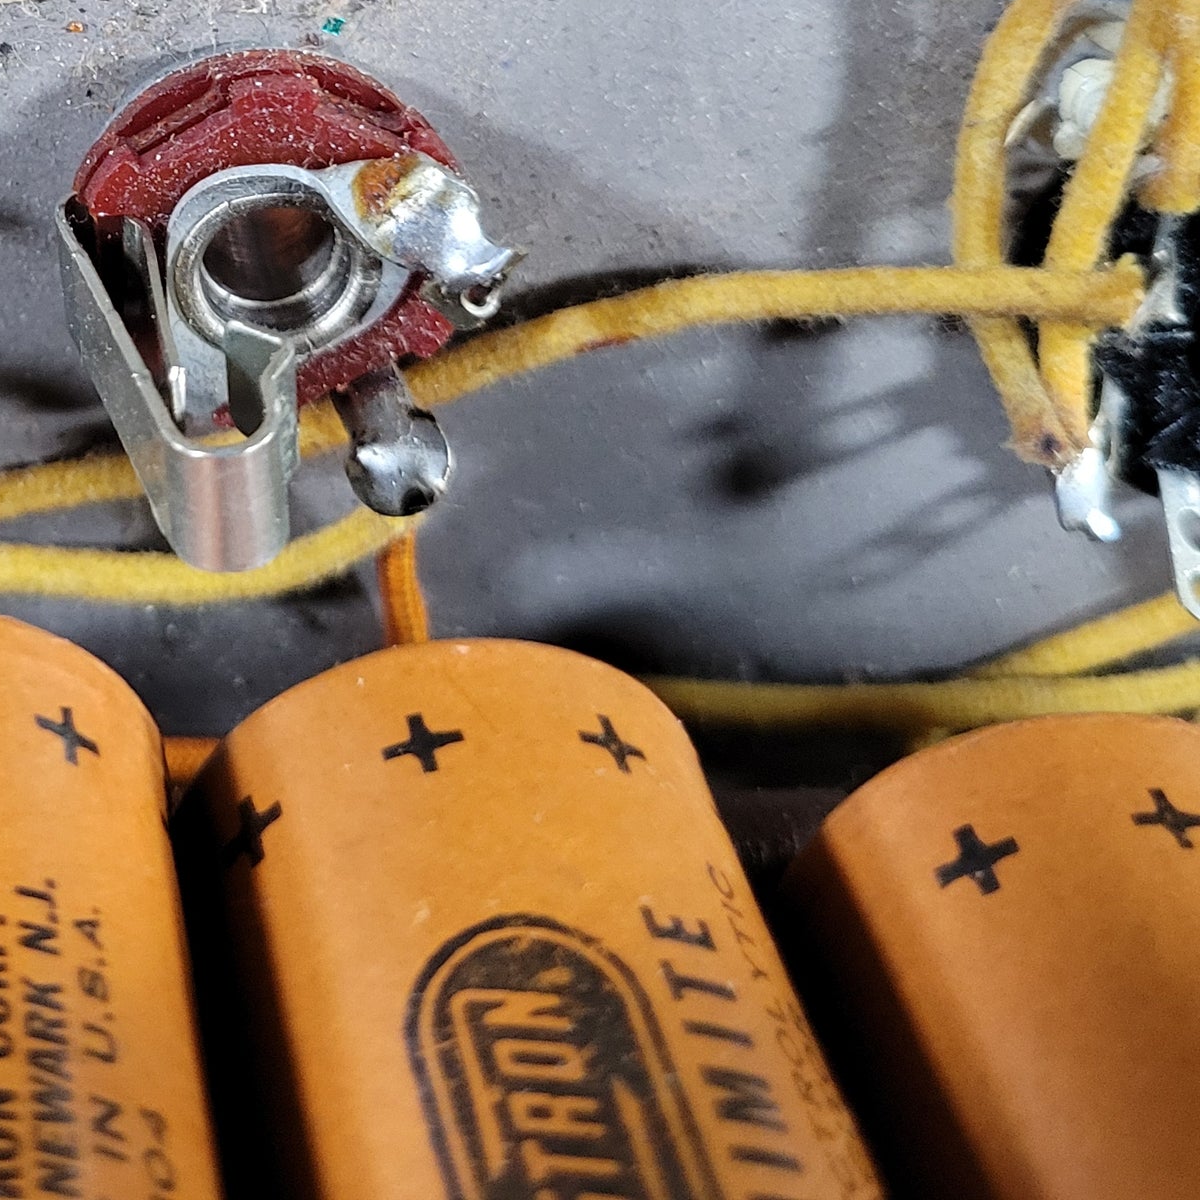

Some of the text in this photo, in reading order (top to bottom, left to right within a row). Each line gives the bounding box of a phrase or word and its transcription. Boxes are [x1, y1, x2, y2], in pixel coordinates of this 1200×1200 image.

[13, 877, 81, 1198] NEWARK N.J.
[73, 906, 129, 1161] IN U.S.A.
[450, 986, 624, 1200] TRON
[640, 903, 806, 1200] IMITE
